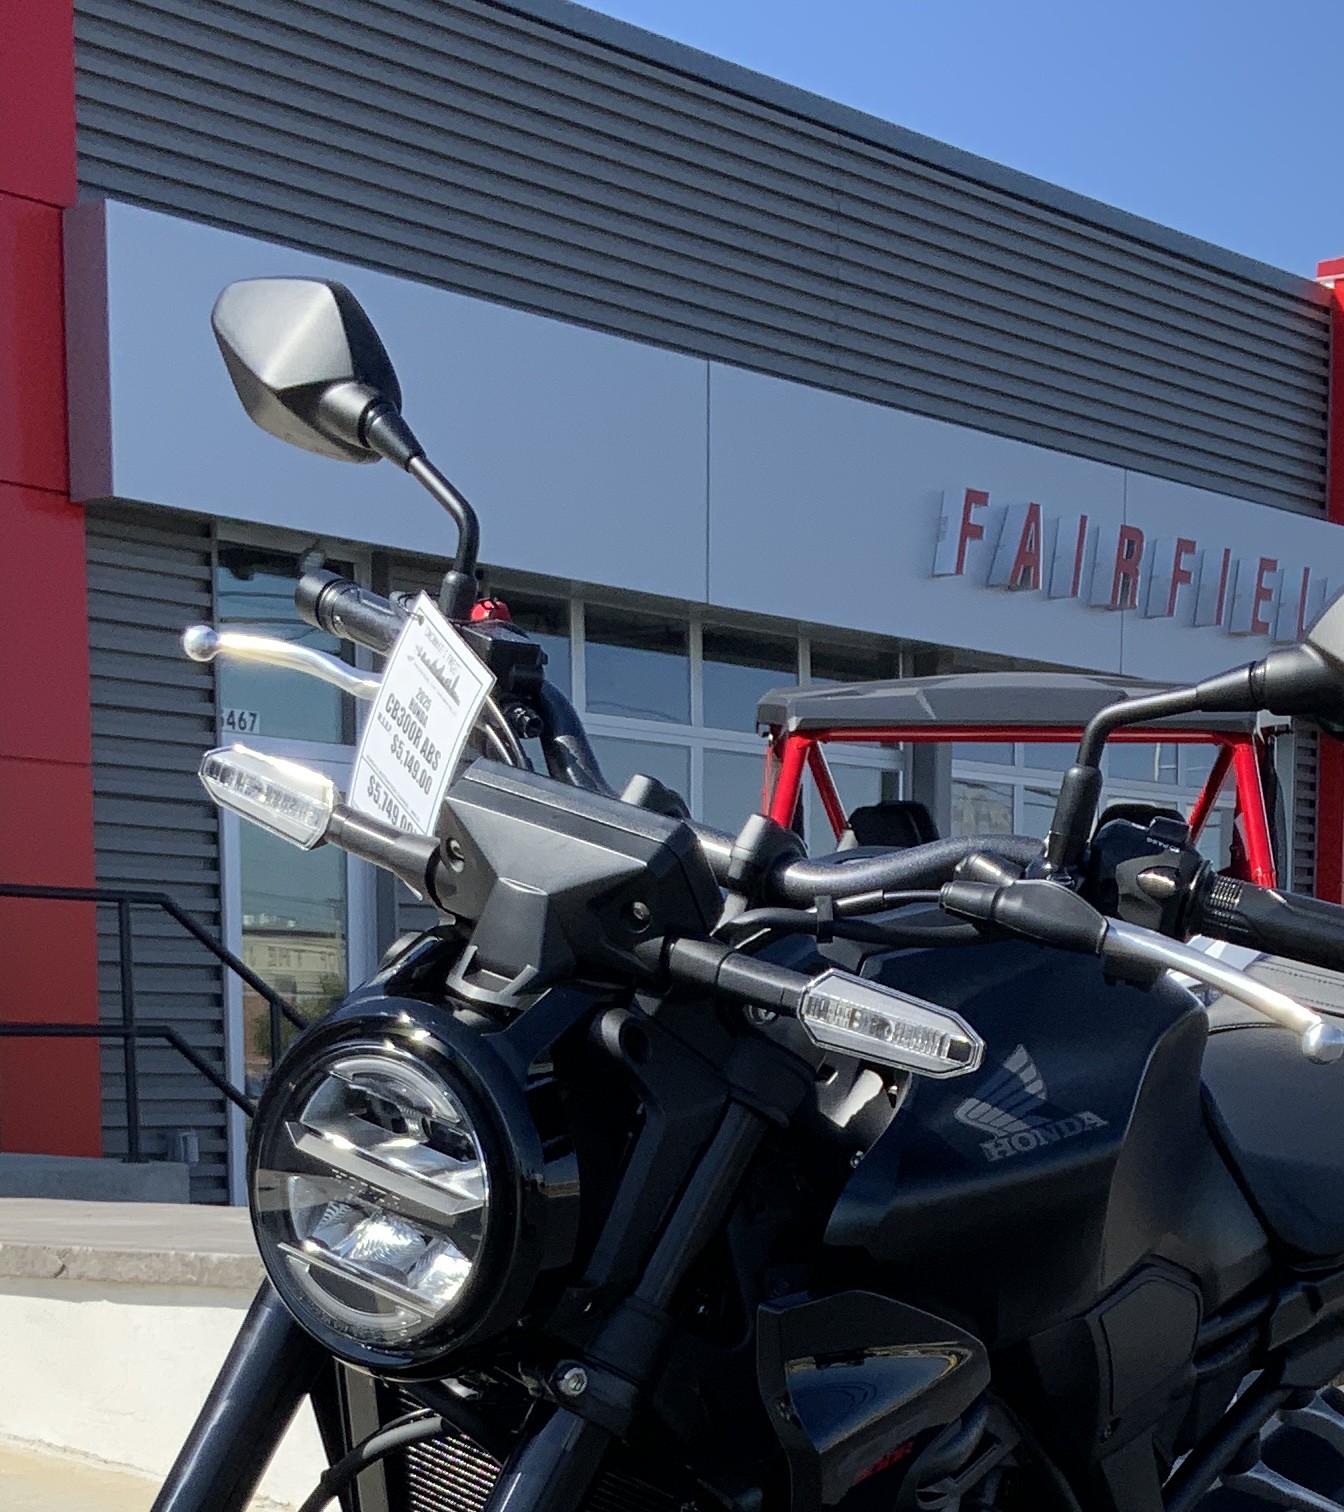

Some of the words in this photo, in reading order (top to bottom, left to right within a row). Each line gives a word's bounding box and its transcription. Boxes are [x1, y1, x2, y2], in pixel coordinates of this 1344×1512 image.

[933, 487, 1336, 643] FAIRFIEL
[385, 692, 423, 750] CB300R
[419, 736, 442, 772] ABS
[390, 733, 433, 796] $5,149.00
[979, 1110, 1110, 1163] HONDA
